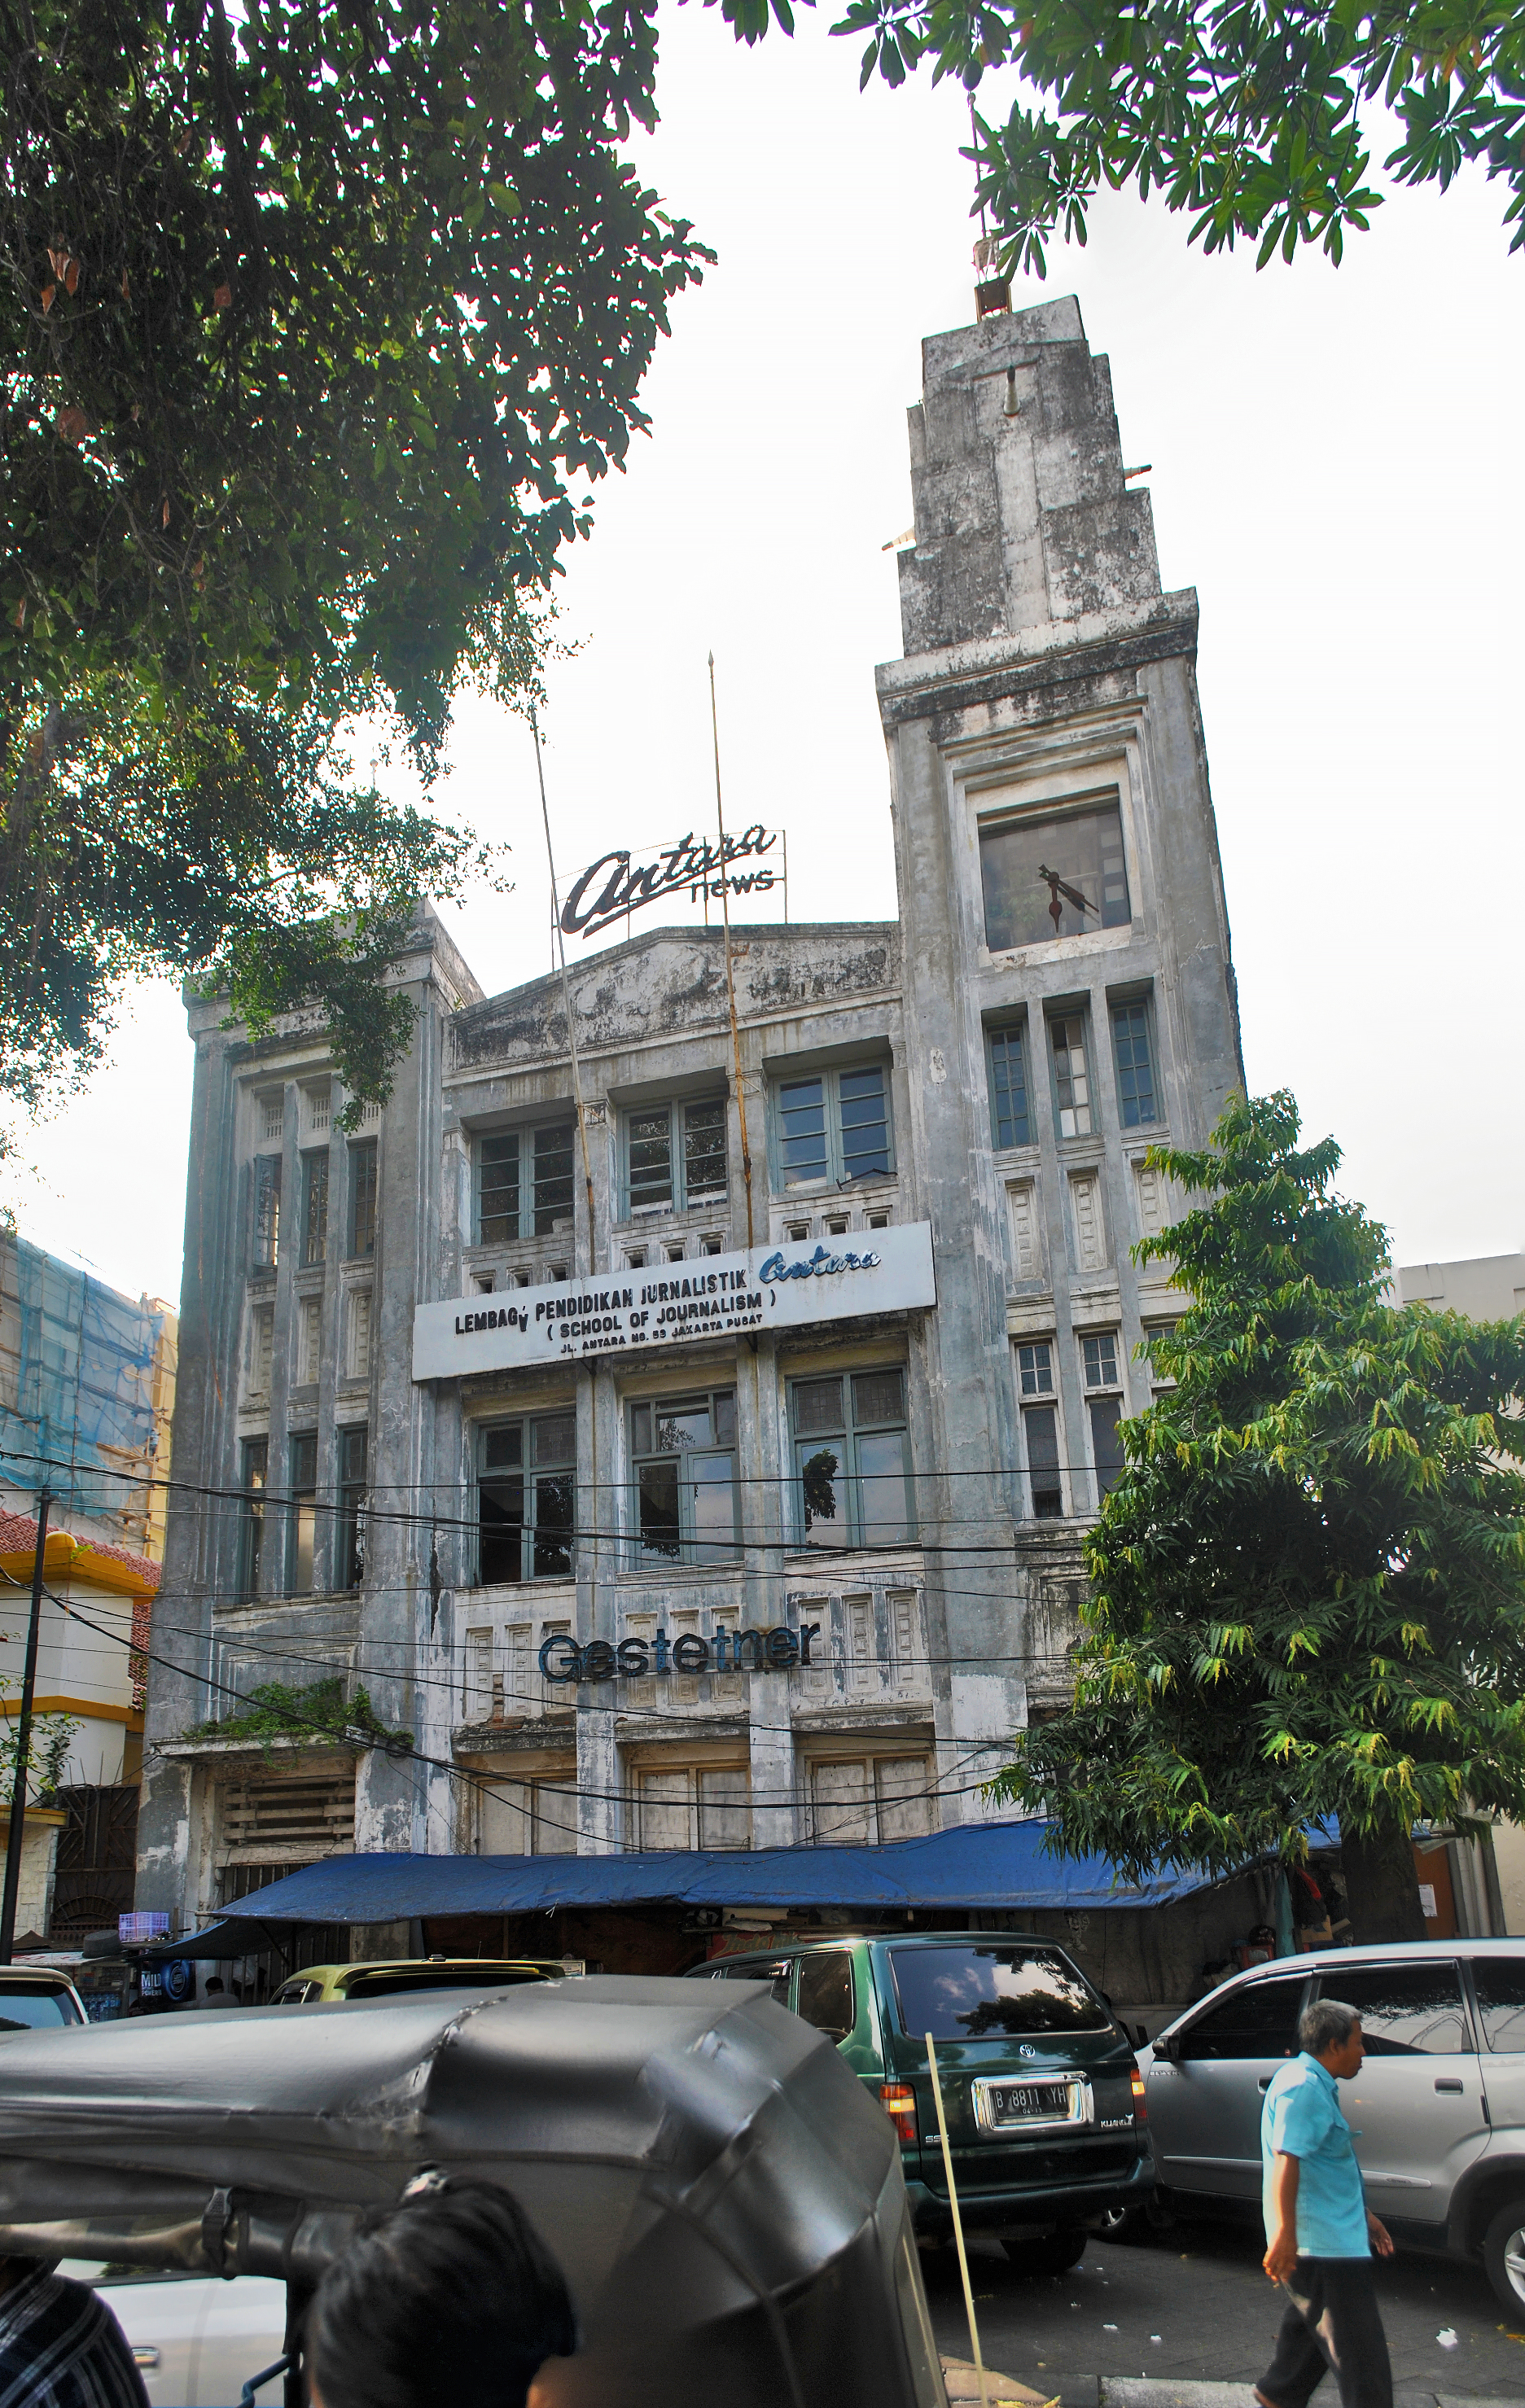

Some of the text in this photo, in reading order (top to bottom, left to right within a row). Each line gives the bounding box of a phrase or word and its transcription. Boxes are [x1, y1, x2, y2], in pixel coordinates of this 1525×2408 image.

[691, 869, 774, 904] news
[455, 1269, 747, 1334] LEMBAGA PENDIDIKAN JURNALISTIK
[560, 1315, 623, 1338] SCHOOL
[629, 1311, 649, 1328] OF
[656, 1292, 762, 1324] JOURNALISM
[560, 1343, 577, 1354] JL.
[582, 1335, 627, 1351] ANTARA
[671, 1320, 723, 1338] JAKARTA
[726, 1313, 763, 1329] PUSAT
[538, 1622, 821, 1683] Gestetner
[141, 1972, 162, 1987] MILD
[995, 2086, 1067, 2108] B 8811 YH
